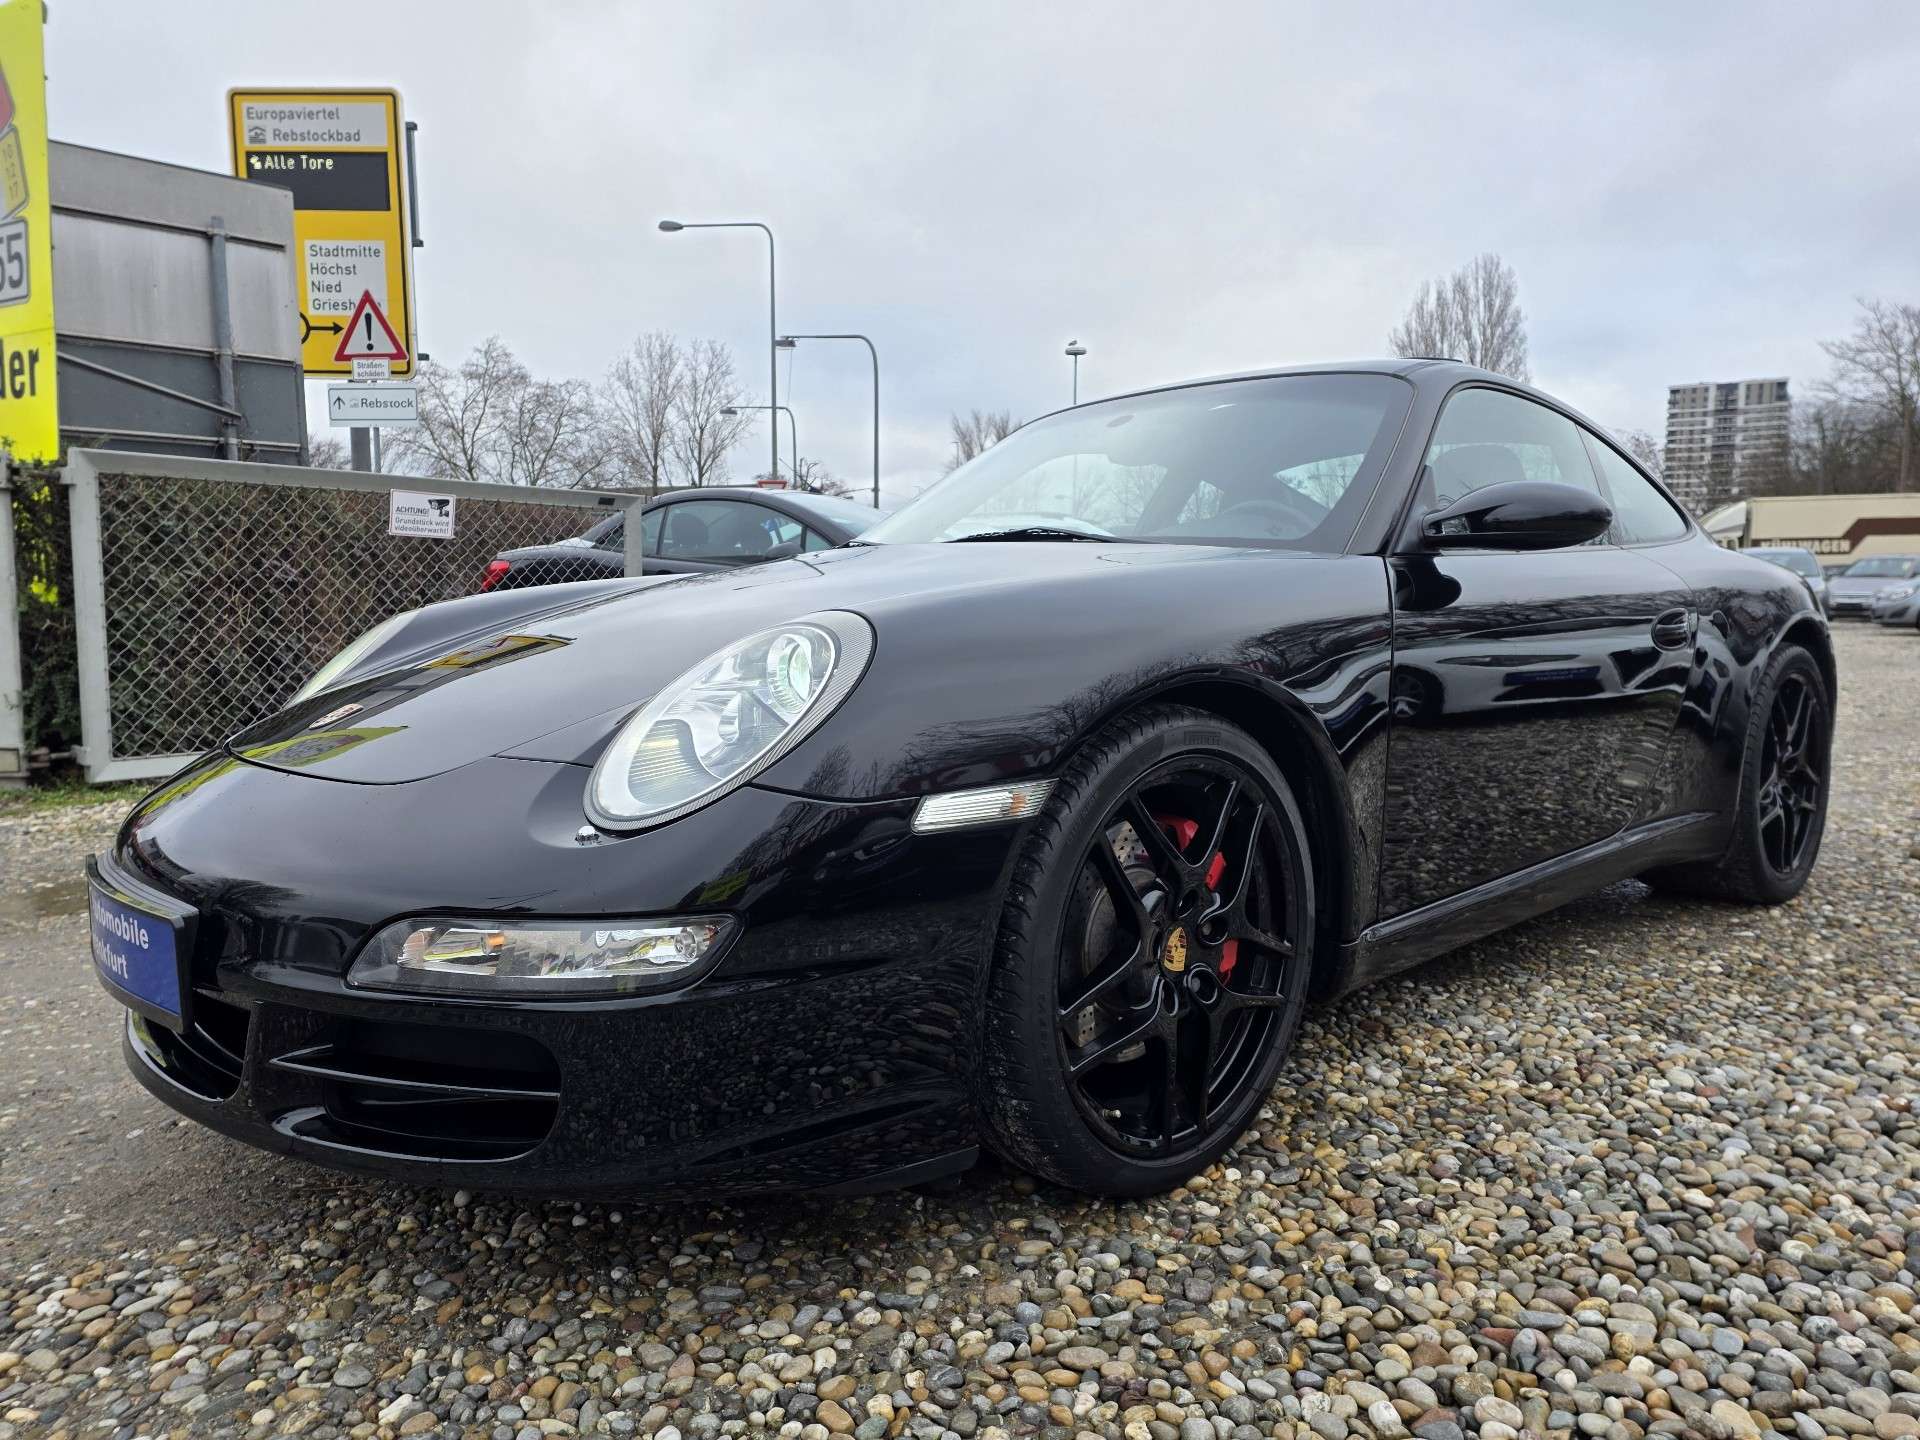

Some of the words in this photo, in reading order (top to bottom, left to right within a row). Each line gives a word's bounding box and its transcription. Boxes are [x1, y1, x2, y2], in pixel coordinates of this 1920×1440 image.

[246, 106, 340, 121] Europaviertel
[272, 129, 361, 142] Rebstockbad
[264, 155, 296, 170] Alle
[300, 154, 334, 170] Tore
[309, 244, 381, 258] Stadtmitte
[310, 262, 357, 275] Höchst
[311, 280, 342, 293] Nied
[312, 298, 381, 311] Griesh
[360, 398, 414, 408] Rebstock
[395, 506, 430, 515] ACHTUNG!
[395, 516, 433, 526] Grundstück
[394, 525, 449, 534] videoüberwacht!
[91, 900, 149, 950] utomobile
